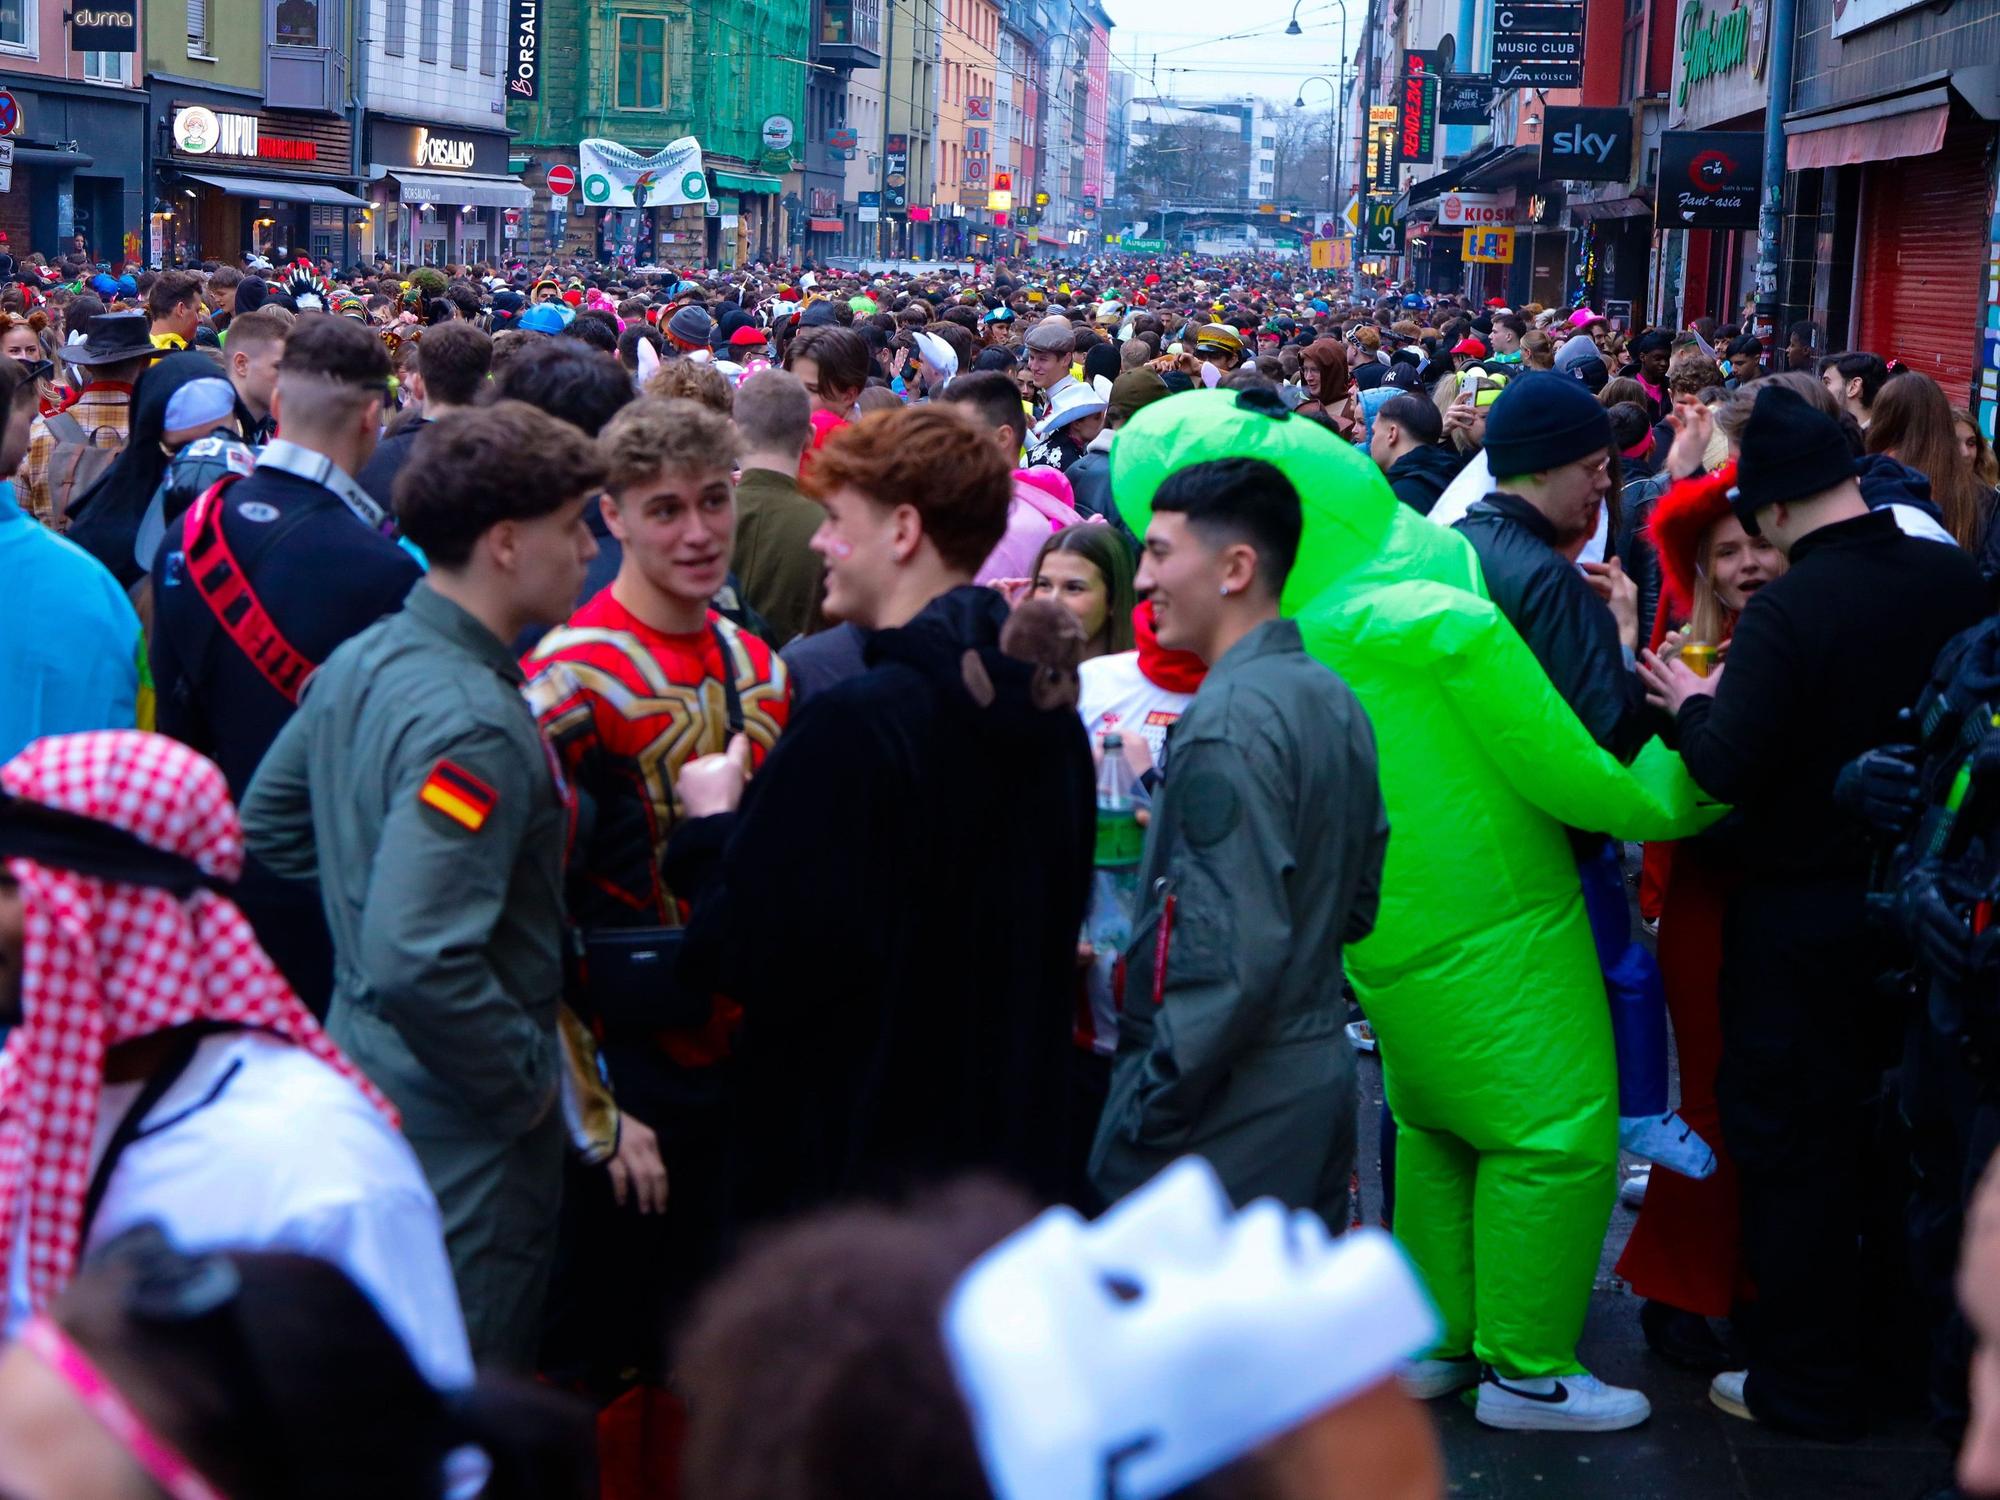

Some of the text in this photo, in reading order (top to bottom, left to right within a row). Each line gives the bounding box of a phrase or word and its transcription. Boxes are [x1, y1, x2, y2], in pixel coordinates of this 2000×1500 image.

[75, 9, 132, 27] duma
[1499, 11, 1514, 28] C
[1497, 43, 1575, 53] MUSIC CLUB
[1534, 73, 1572, 81] KÖLSCH
[1370, 108, 1395, 120] alafel
[1403, 54, 1424, 158] RENDEZVUS
[222, 114, 258, 157] NAPOLI
[1552, 123, 1618, 164] sky
[416, 127, 474, 168] BORSALINO
[1678, 192, 1742, 207] Fant-asia
[1464, 207, 1516, 222] KIOSK
[1125, 240, 1161, 249] Ausgang
